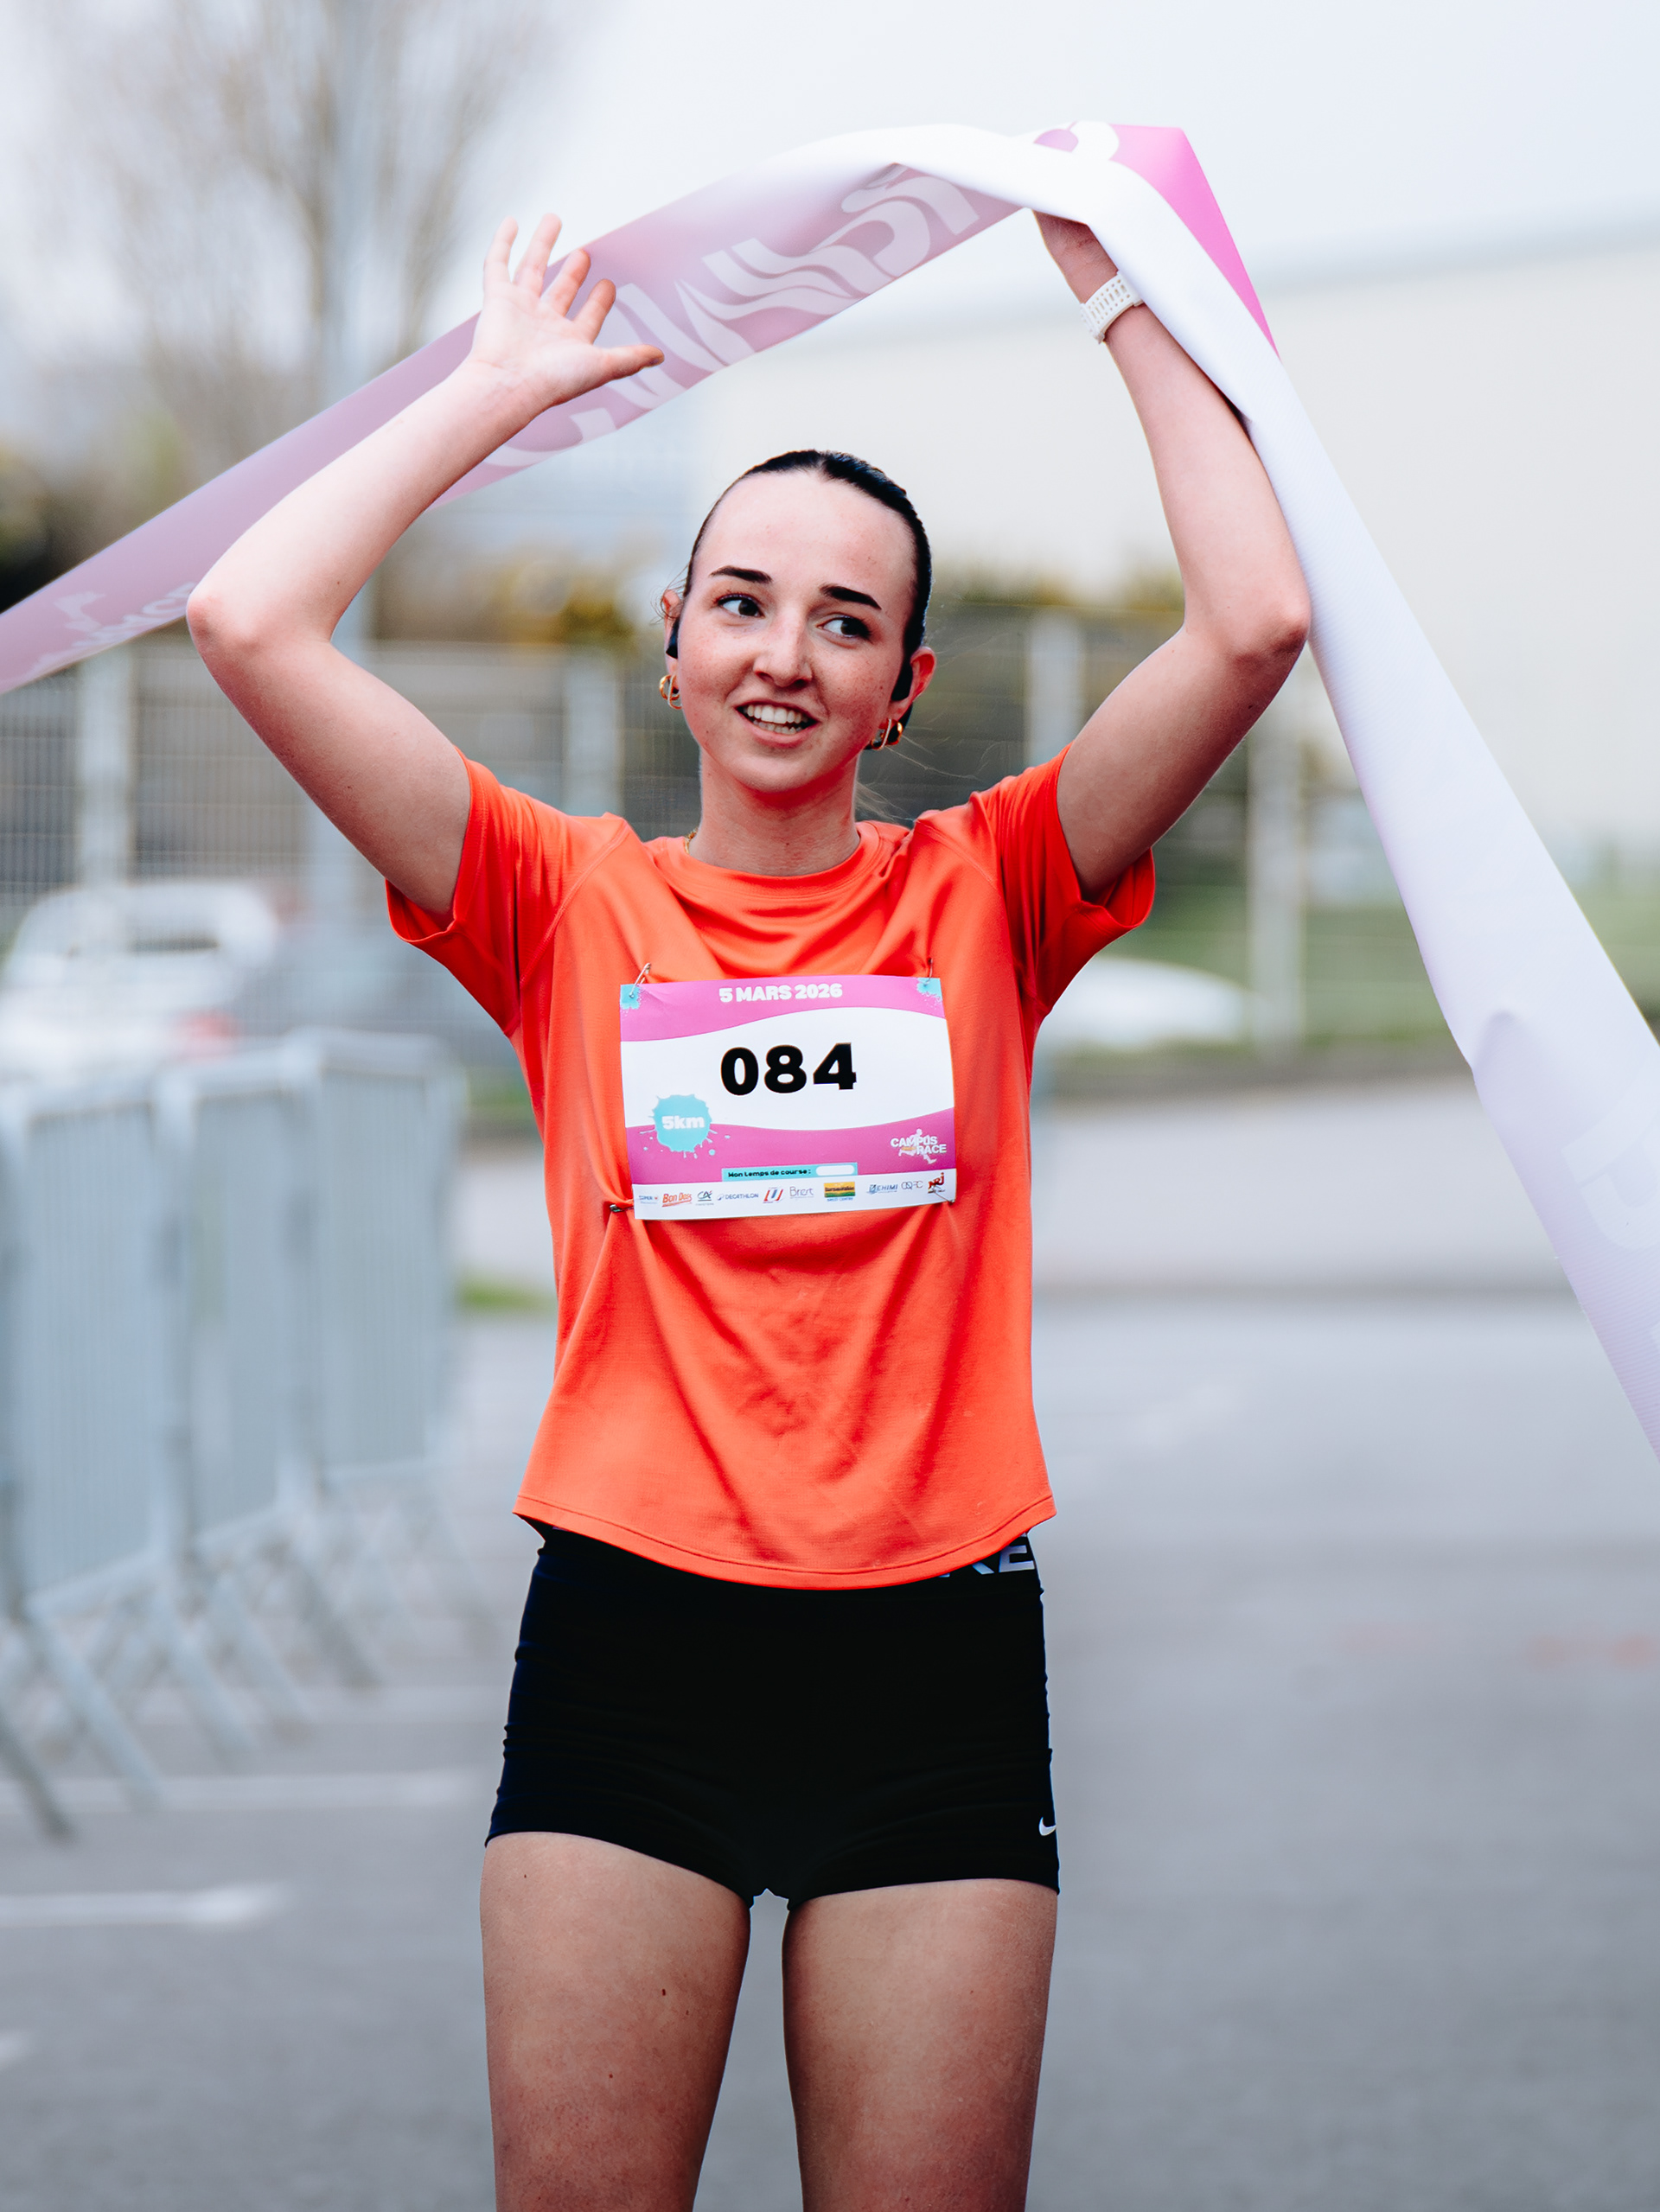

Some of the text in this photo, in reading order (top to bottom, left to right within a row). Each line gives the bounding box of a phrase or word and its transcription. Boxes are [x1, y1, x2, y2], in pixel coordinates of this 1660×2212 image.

[719, 983, 843, 1003] 5 MARS 2026
[720, 1042, 857, 1096] 084
[661, 1114, 705, 1130] 5km
[891, 1135, 938, 1148] CAMPUS
[916, 1144, 947, 1155] RACE
